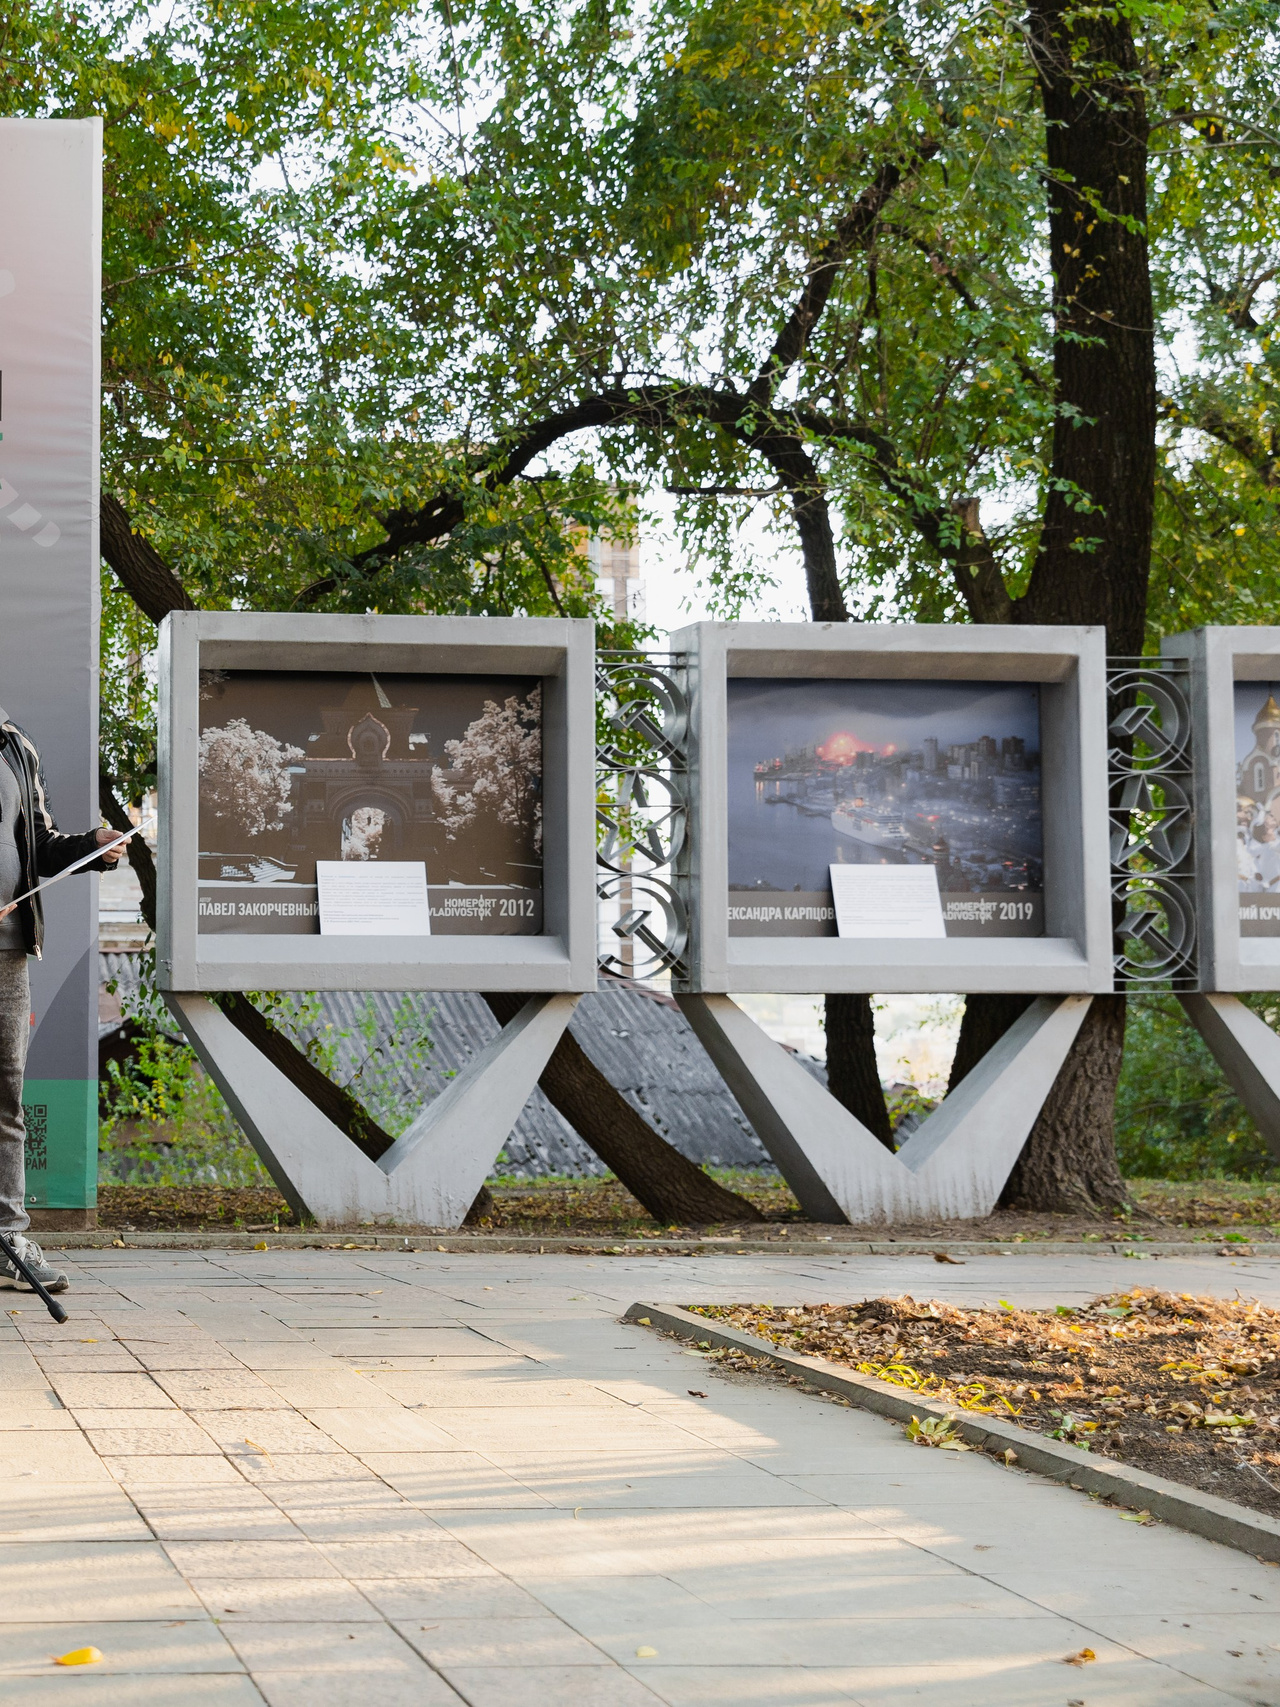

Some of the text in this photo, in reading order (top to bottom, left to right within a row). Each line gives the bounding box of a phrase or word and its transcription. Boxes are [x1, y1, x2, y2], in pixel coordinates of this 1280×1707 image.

[199, 901, 320, 916] ПАВЕЛ ЗАКОРЧЕВНЫЙ
[444, 898, 497, 908] HOMEPORT
[499, 899, 534, 917] 2012
[946, 902, 998, 911] HOMEPORT
[727, 906, 835, 922] ЕКСАНДРА КАРПЦОВ
[942, 911, 993, 921] ADIVOSTOK
[999, 902, 1033, 920] 2019
